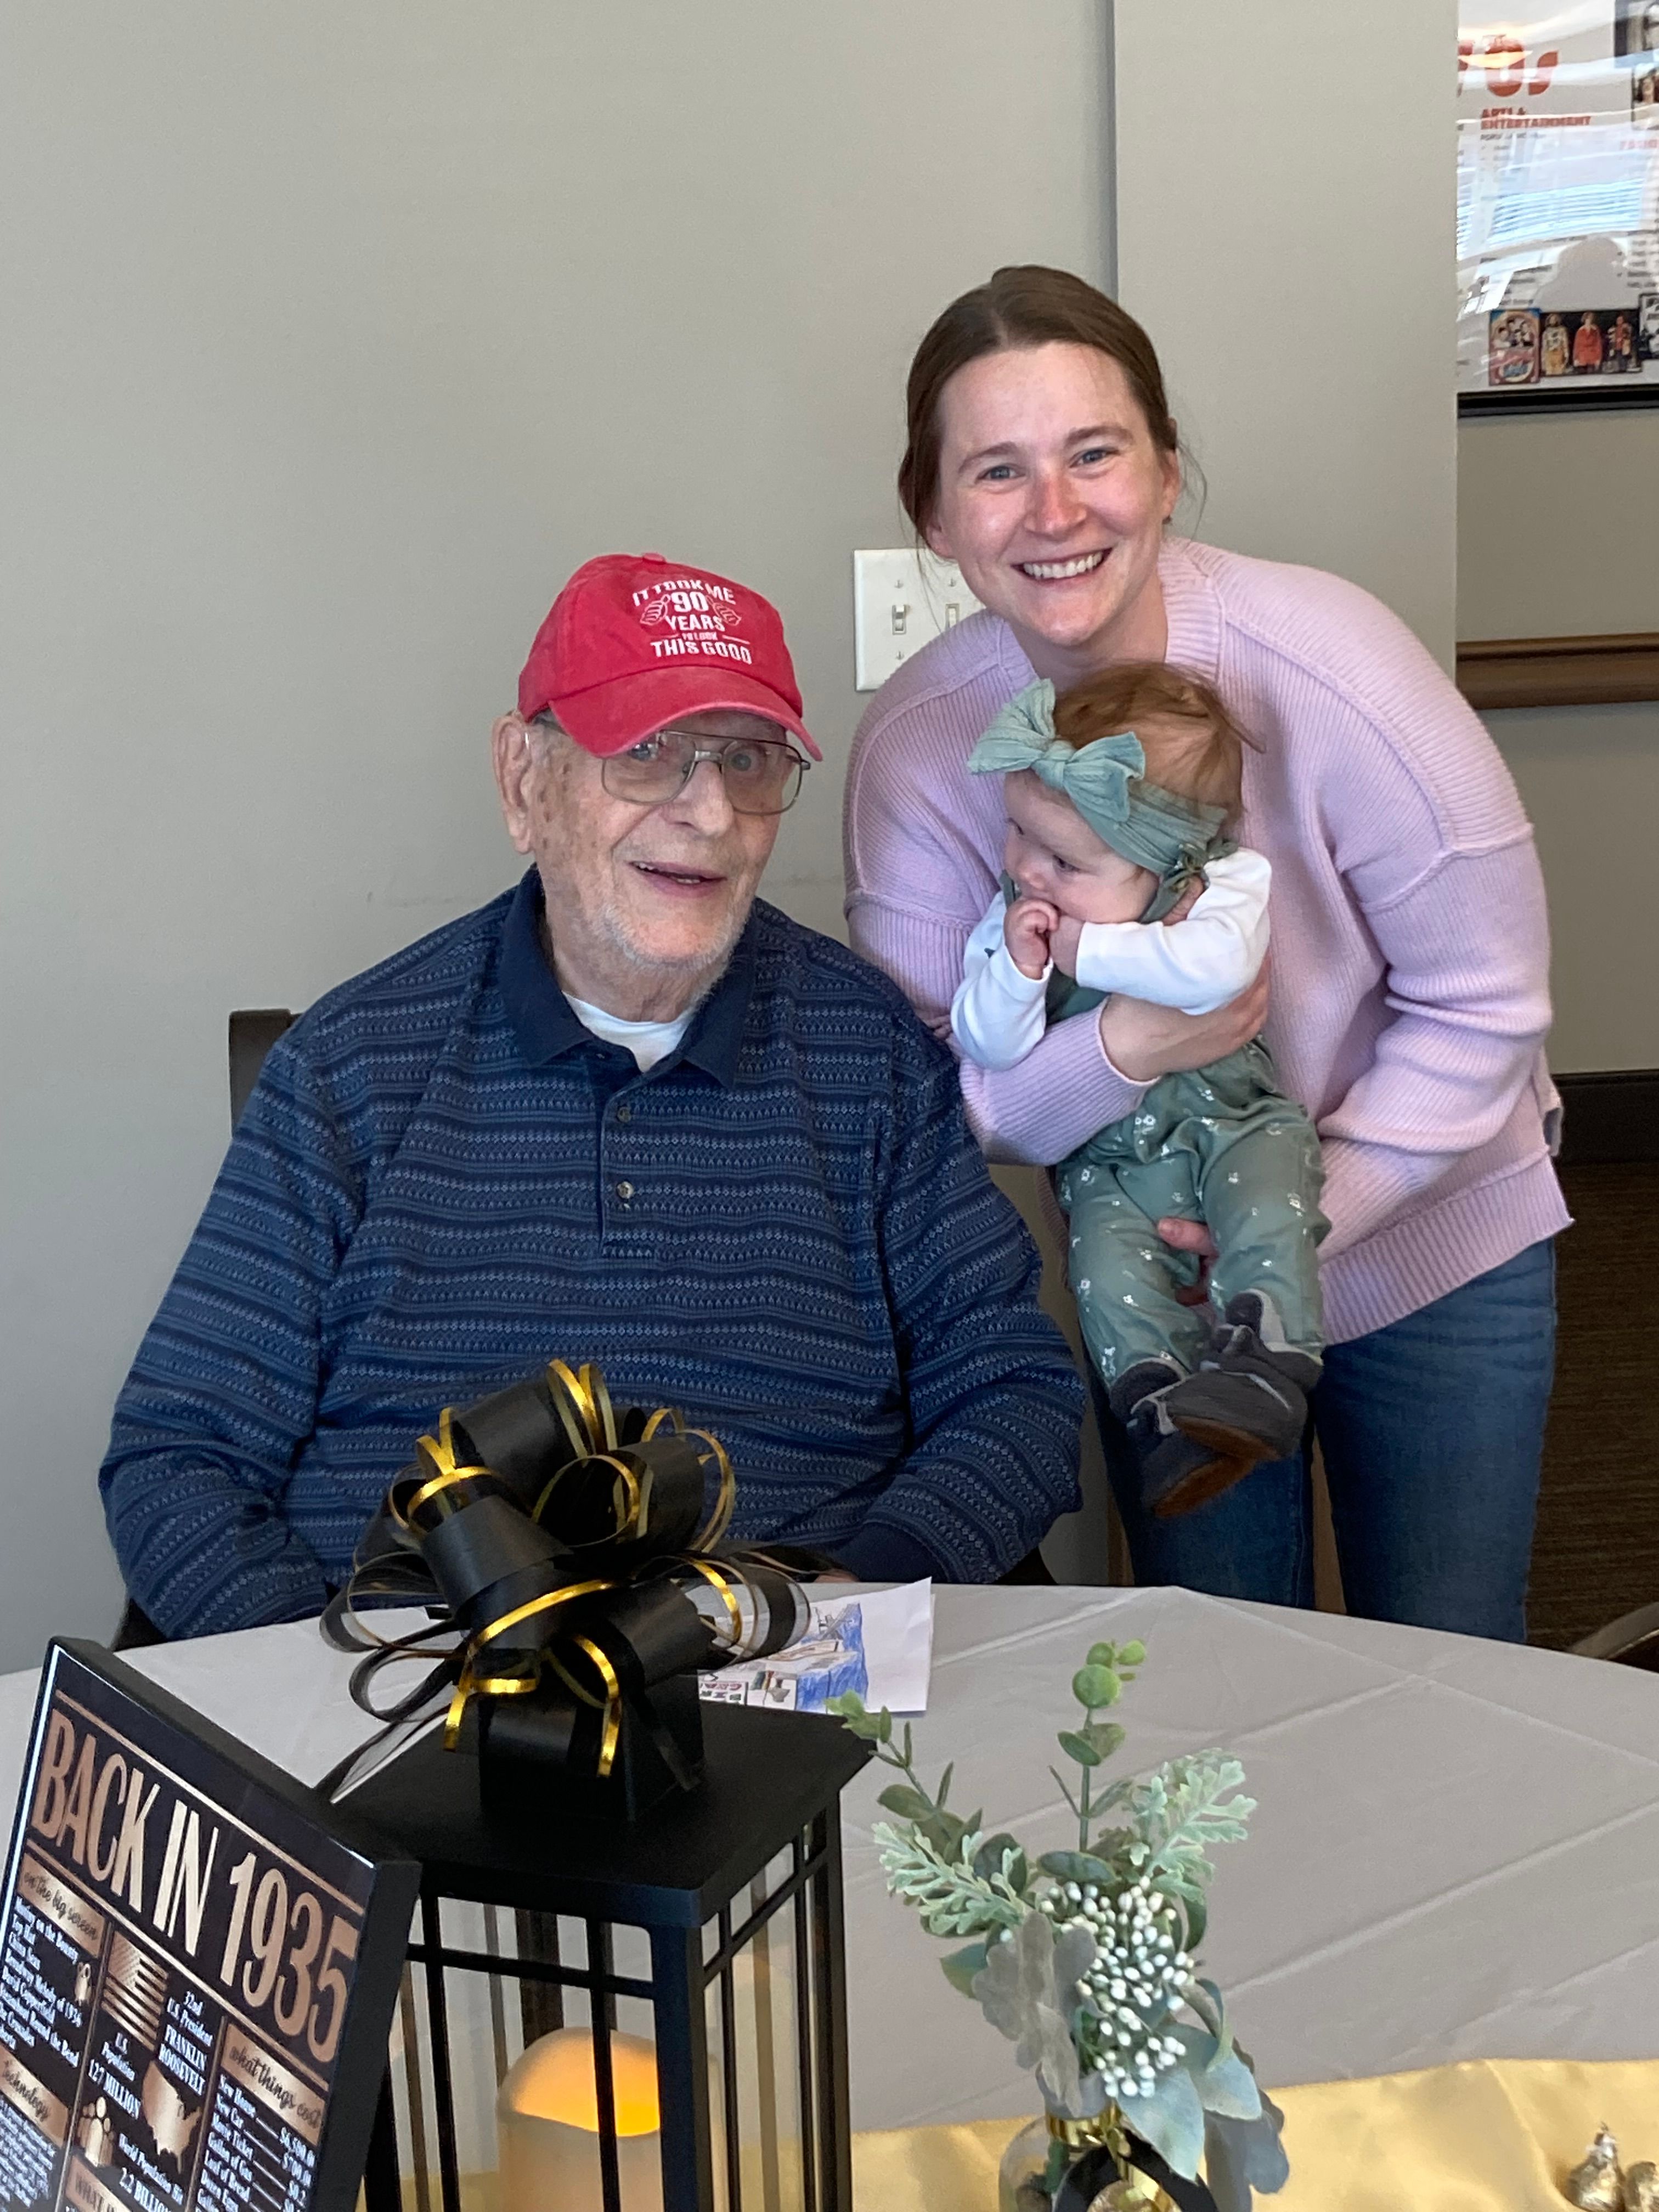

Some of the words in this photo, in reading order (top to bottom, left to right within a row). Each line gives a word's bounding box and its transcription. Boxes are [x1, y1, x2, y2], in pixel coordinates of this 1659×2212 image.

[633, 586, 650, 606] IT
[651, 579, 705, 594] TOOK
[704, 583, 736, 605] ME
[670, 591, 709, 612] 90
[665, 614, 725, 631] YEARS
[650, 638, 699, 658] THIS
[701, 640, 752, 665] GOOD
[31, 1709, 160, 1913] BACK
[152, 1799, 218, 1956] IN
[220, 1853, 358, 2062] 1935
[53, 1890, 66, 1919] big
[67, 1908, 97, 1940] screen
[184, 1991, 202, 2016] 32nd
[180, 2010, 212, 2046] President
[101, 2042, 135, 2081] Population
[165, 2025, 206, 2070] FRANKLIN
[159, 2044, 205, 2095] ROOSEVELT
[258, 2062, 296, 2109] things
[88, 2059, 104, 2084] 127
[104, 2073, 140, 2119] MILLION
[120, 2168, 134, 2193] 2.2
[288, 2181, 306, 2208] $0.2
